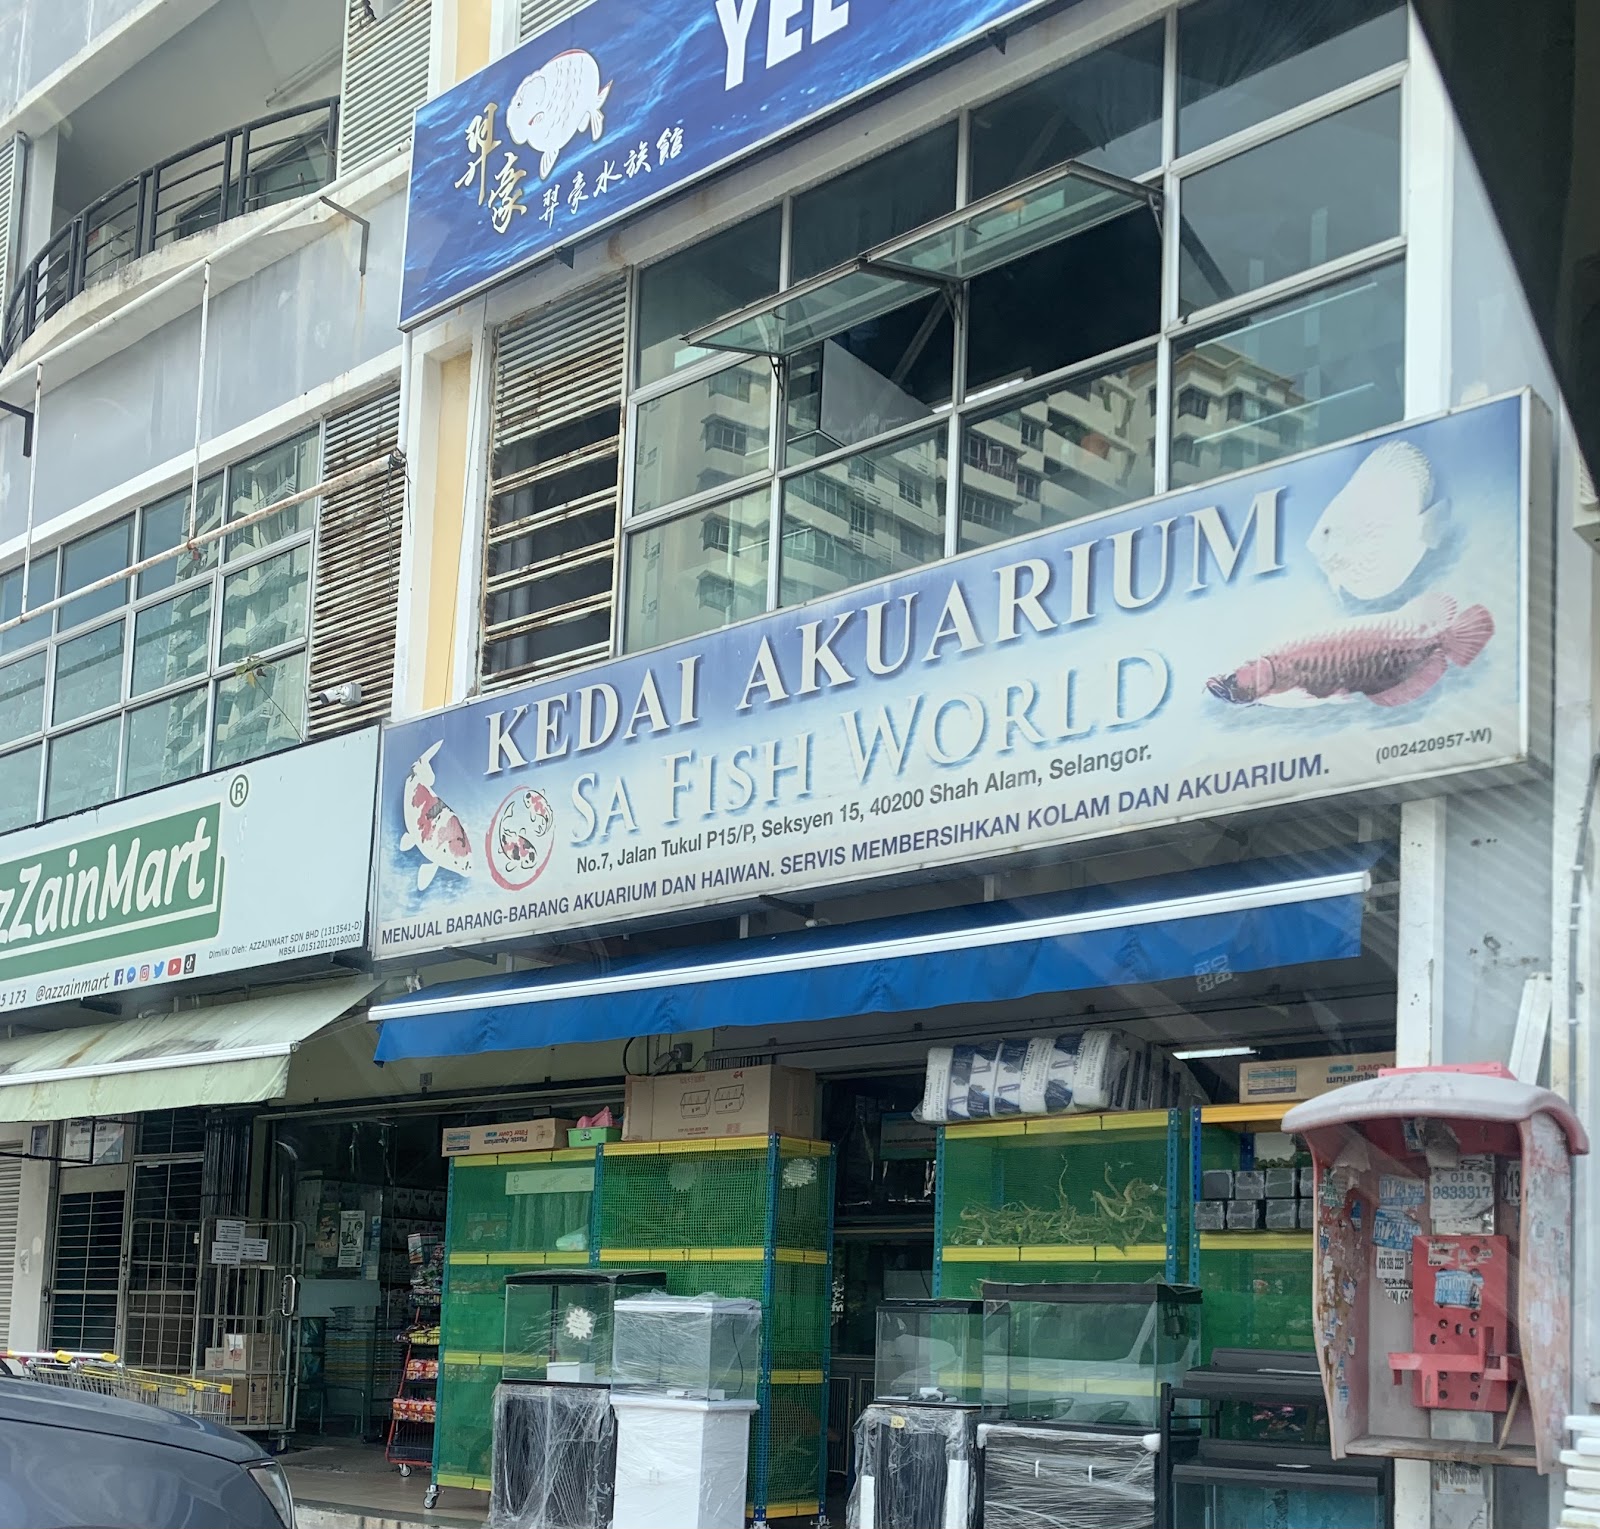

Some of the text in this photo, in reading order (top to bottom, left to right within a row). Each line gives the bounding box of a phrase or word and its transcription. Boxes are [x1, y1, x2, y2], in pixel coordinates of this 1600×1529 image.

[484, 486, 1288, 777] KEDAI AKUARIUM
[571, 648, 1174, 847] SA FISH WORLD
[1376, 727, 1493, 764] (002420957-W)
[381, 753, 1330, 945] MENJUAL BARANG-BARANG AKUARIUM DAN HAIWAN. SERVIS MEMBERSIHKAN KOLAM DAN AKUARIUM.
[577, 743, 1152, 874] No.7, Jalan Tukul P15/P, Seksyen 15, 40200 Shah Alam, Selangor.
[208, 920, 363, 960] Dimiliki Oleh: AZZAINMART SDN BHD (1313541-D)
[278, 946, 296, 957] MBSA
[9, 989, 27, 1006] 173
[36, 972, 110, 1002] @azzainmart
